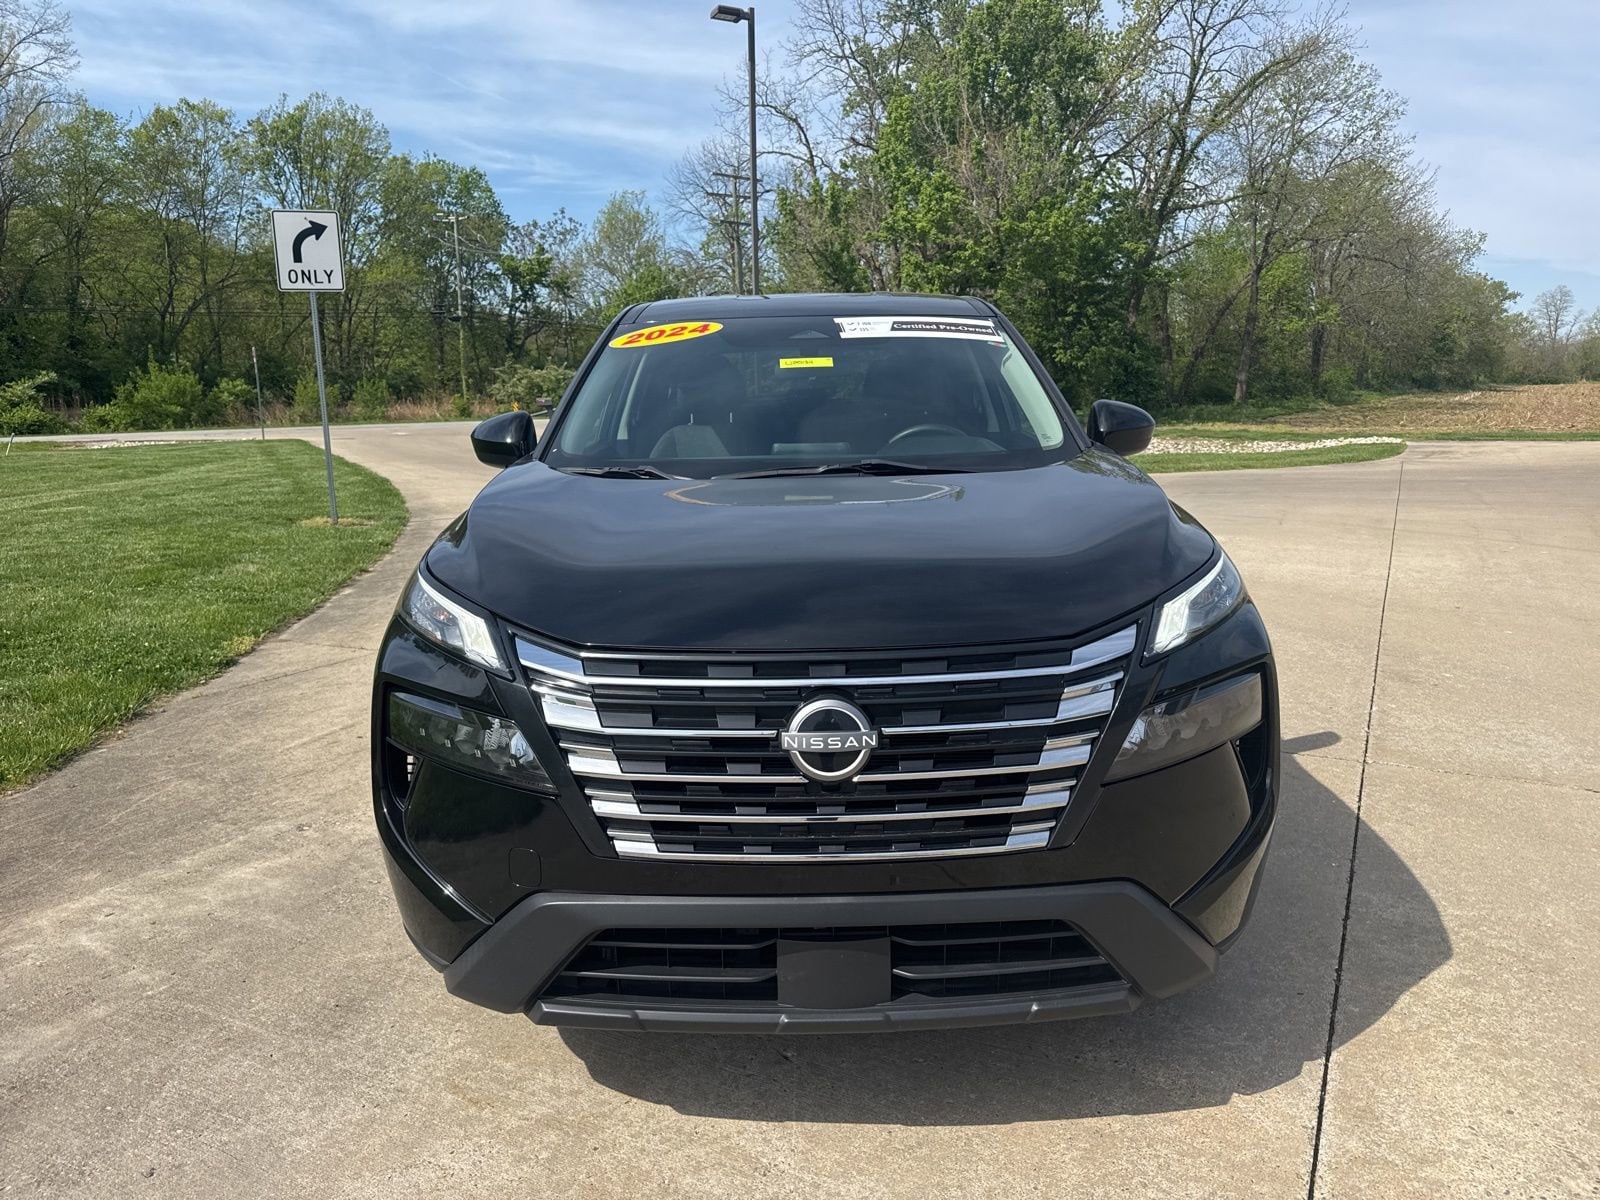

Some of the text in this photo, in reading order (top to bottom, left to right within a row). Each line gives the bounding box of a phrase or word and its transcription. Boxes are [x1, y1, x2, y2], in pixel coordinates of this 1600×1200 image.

[288, 269, 333, 285] ONLY
[621, 323, 710, 346] 2024
[938, 324, 993, 334] Pre-Owned
[784, 734, 876, 749] NISSAN
